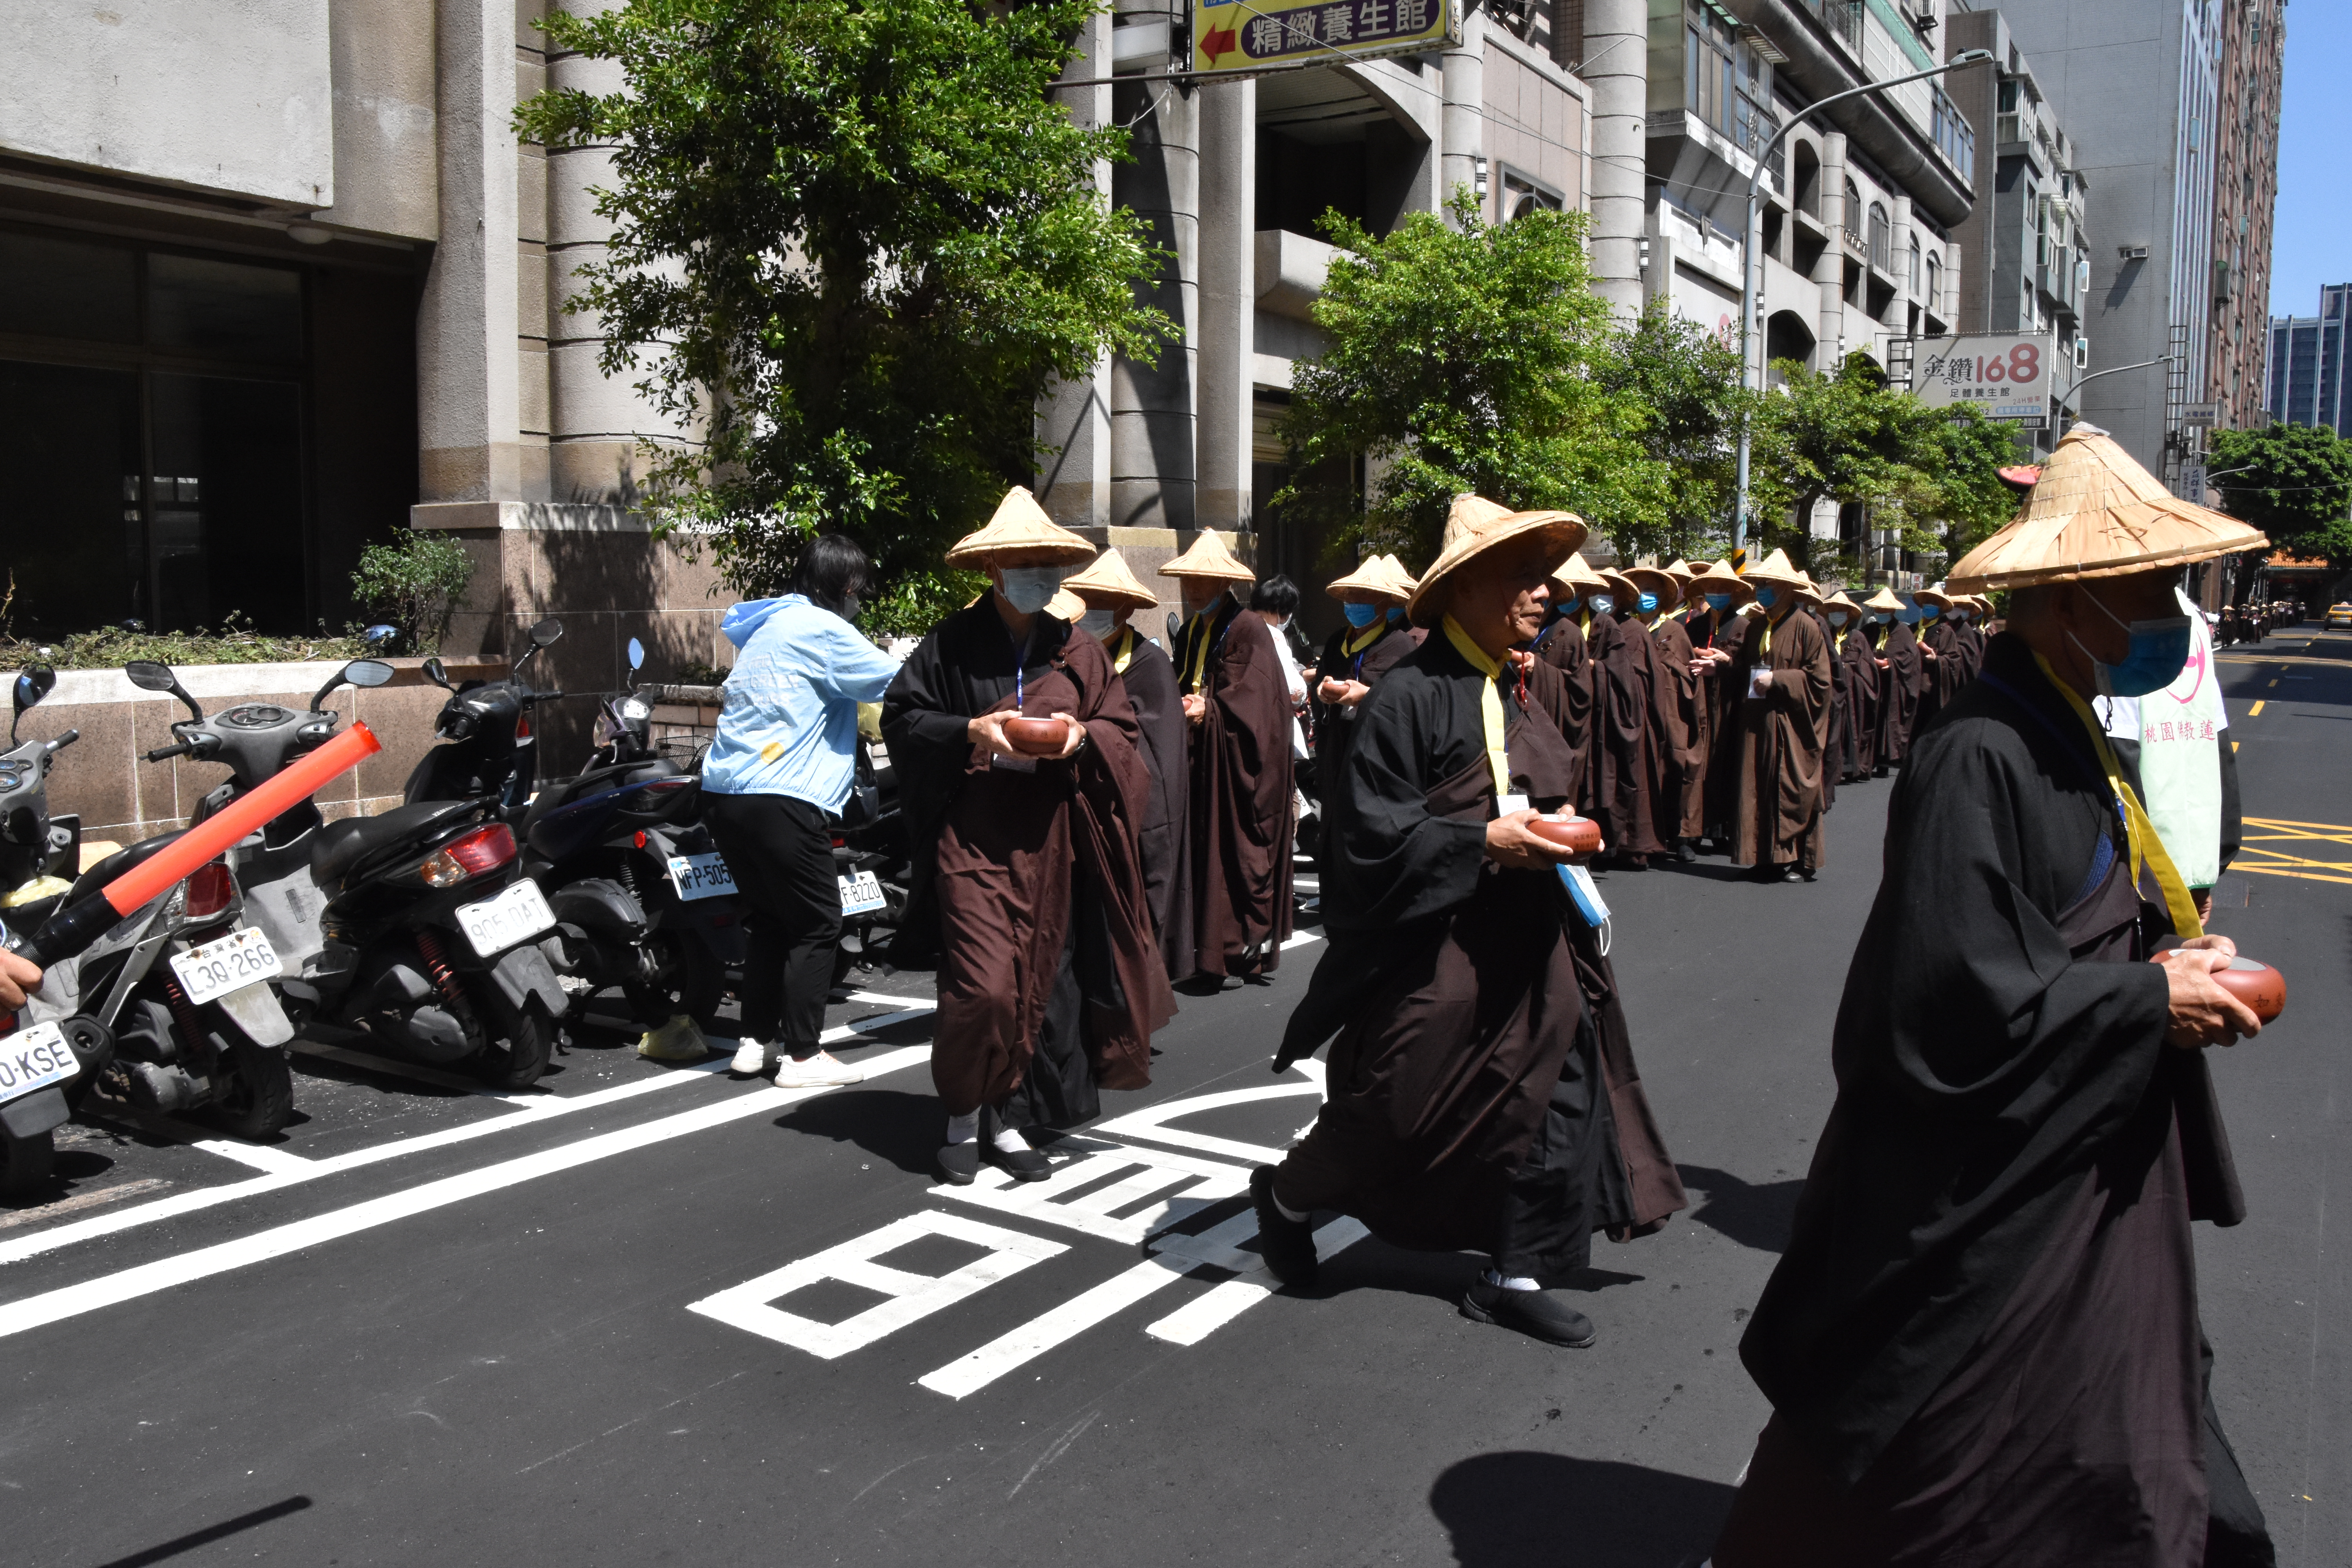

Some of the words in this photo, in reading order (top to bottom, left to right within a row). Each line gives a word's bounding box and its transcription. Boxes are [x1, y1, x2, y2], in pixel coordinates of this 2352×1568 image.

[1252, 0, 1427, 54] 精緻養生館
[1950, 387, 2010, 398] 足體養生館
[432, 806, 457, 817] YAMA
